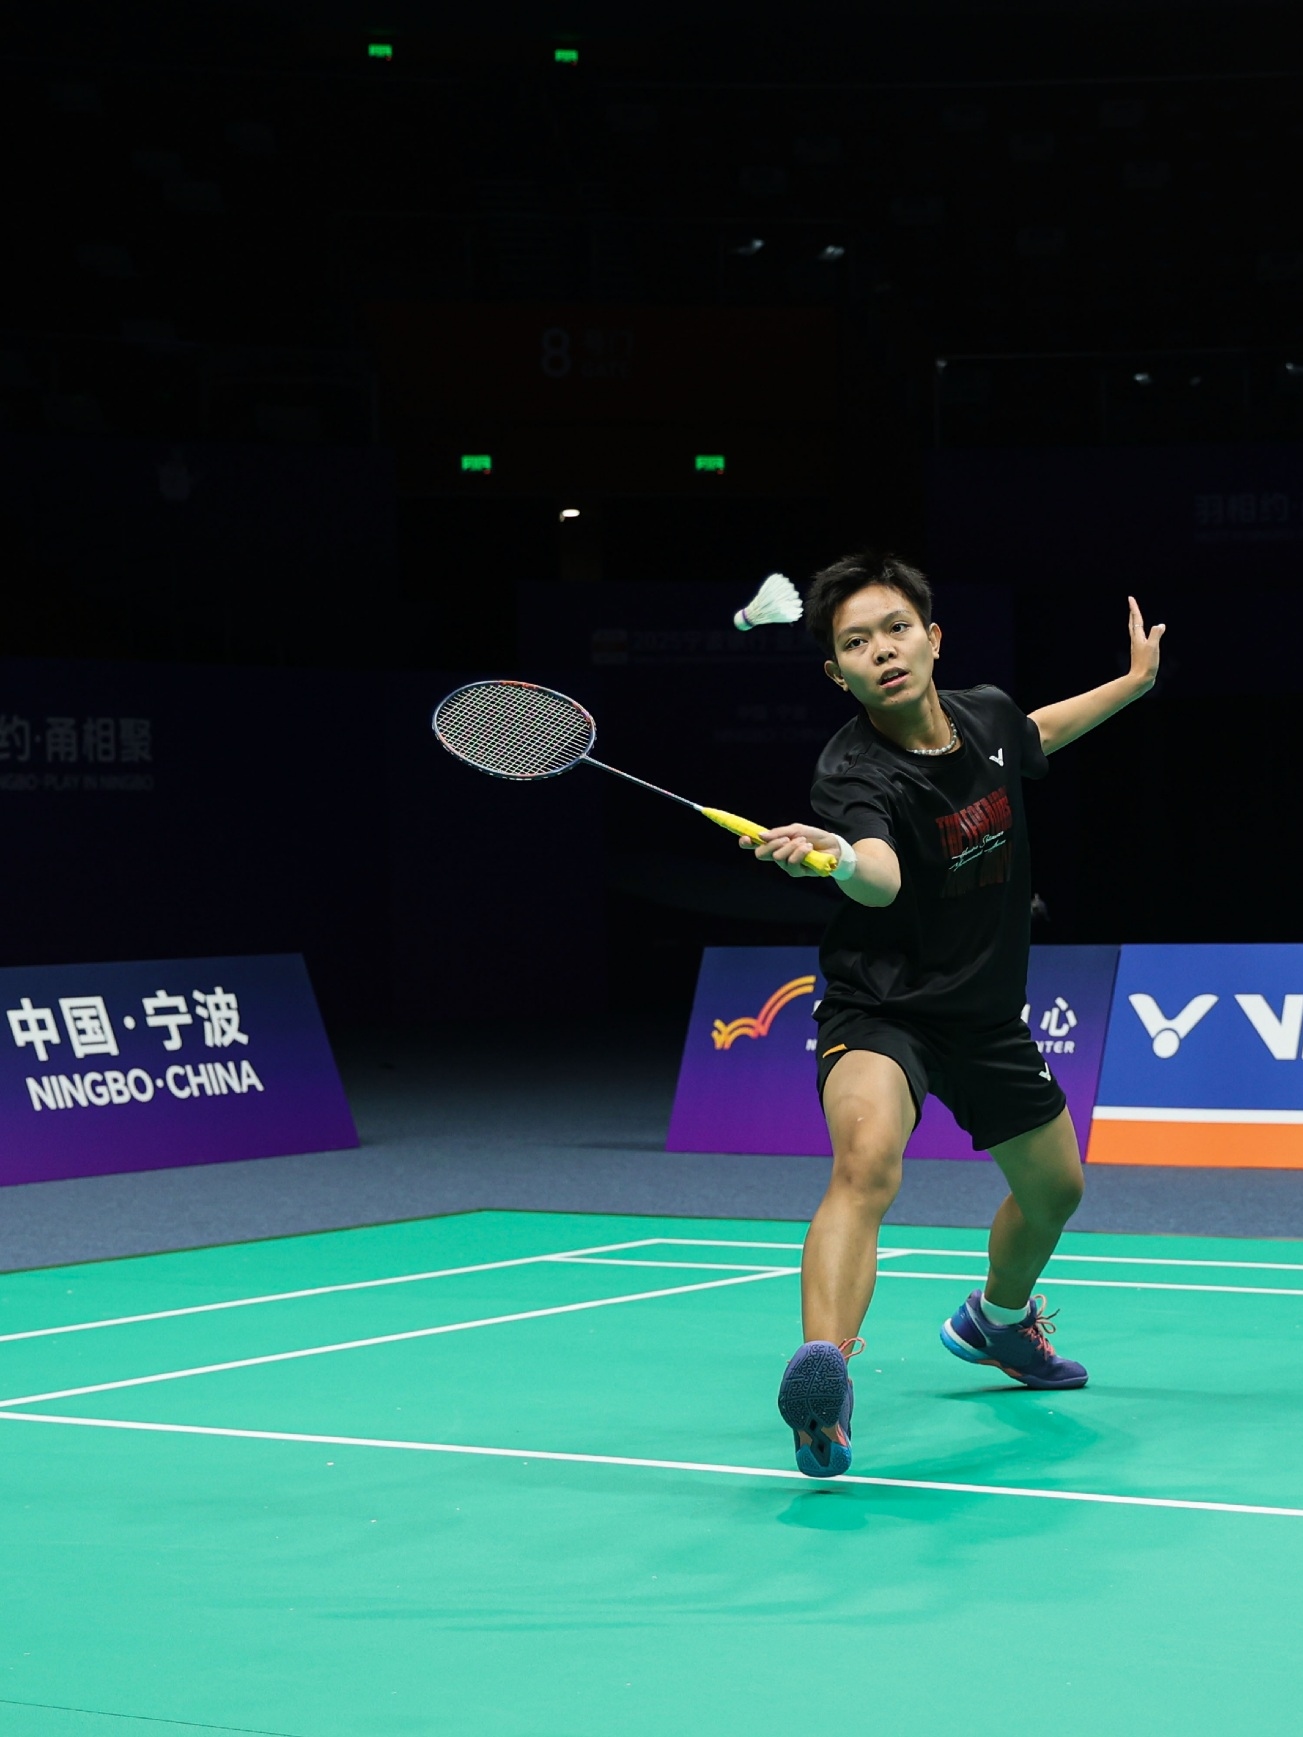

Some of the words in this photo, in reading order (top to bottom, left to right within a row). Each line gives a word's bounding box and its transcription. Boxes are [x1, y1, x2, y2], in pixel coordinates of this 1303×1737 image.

[6, 985, 249, 1061] 中国·宁波
[25, 1059, 265, 1112] NINGBO·CHINA
